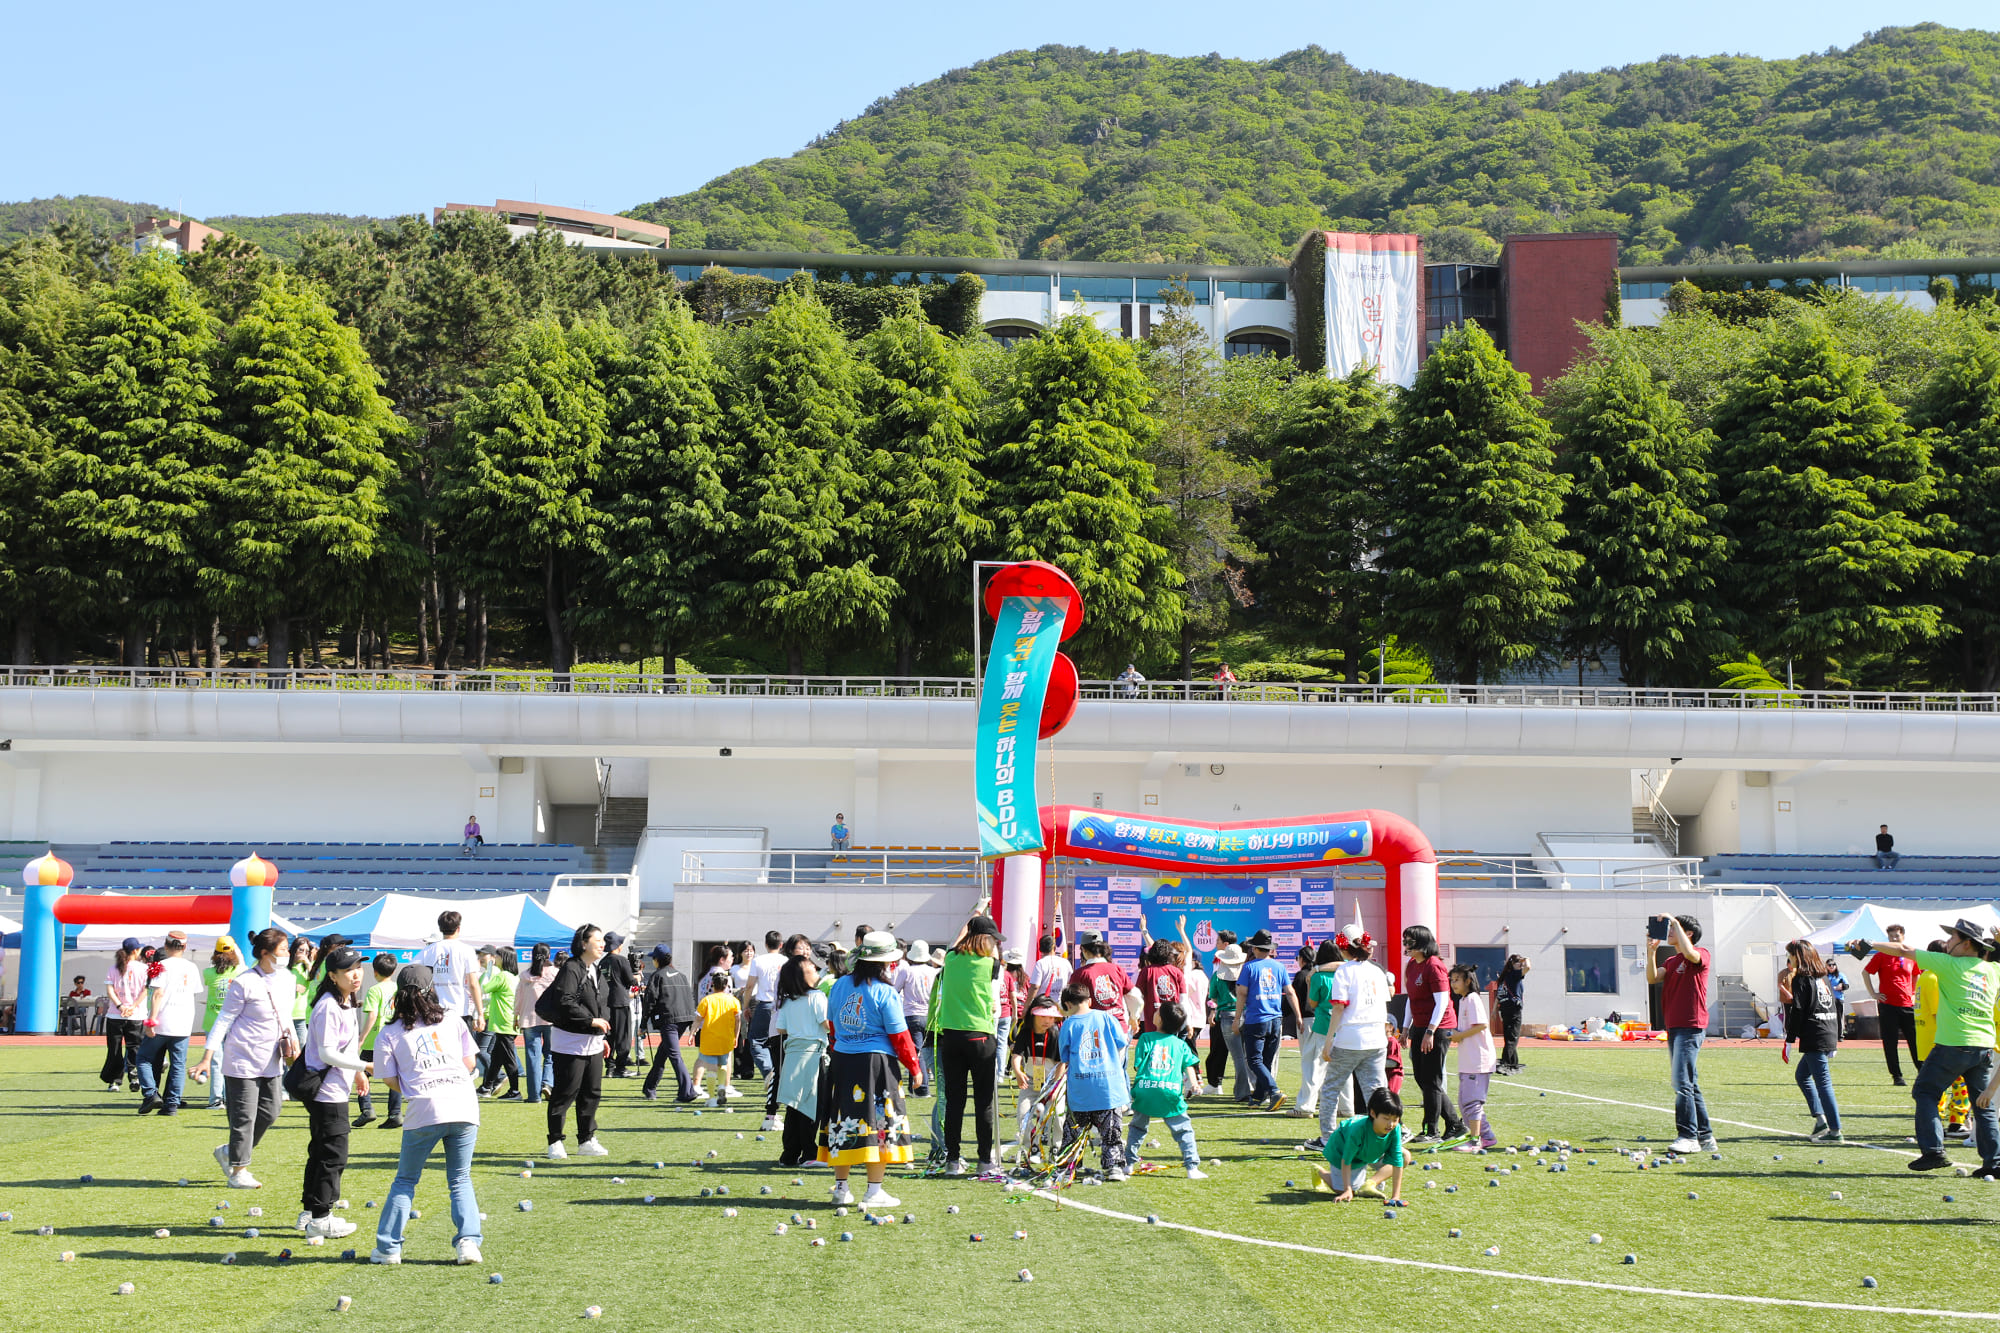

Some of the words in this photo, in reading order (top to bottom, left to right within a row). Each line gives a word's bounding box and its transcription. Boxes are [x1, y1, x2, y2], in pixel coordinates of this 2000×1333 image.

[1016, 611, 1045, 635] 함께
[1001, 671, 1028, 700] 함께
[998, 702, 1021, 734] 웃는
[995, 735, 1017, 786] 하나의
[997, 788, 1018, 840] BDU
[1114, 821, 1148, 841] 함께
[1147, 827, 1181, 846] 뛰고,
[1183, 831, 1217, 850] 함께
[1217, 836, 1246, 851] 웃는
[1247, 832, 1294, 850] 하나의
[1297, 830, 1330, 847] BDU
[1156, 895, 1171, 904] 함께
[1188, 896, 1203, 904] 함께
[1218, 896, 1240, 904] 하나의
[1240, 896, 1256, 904] BDU
